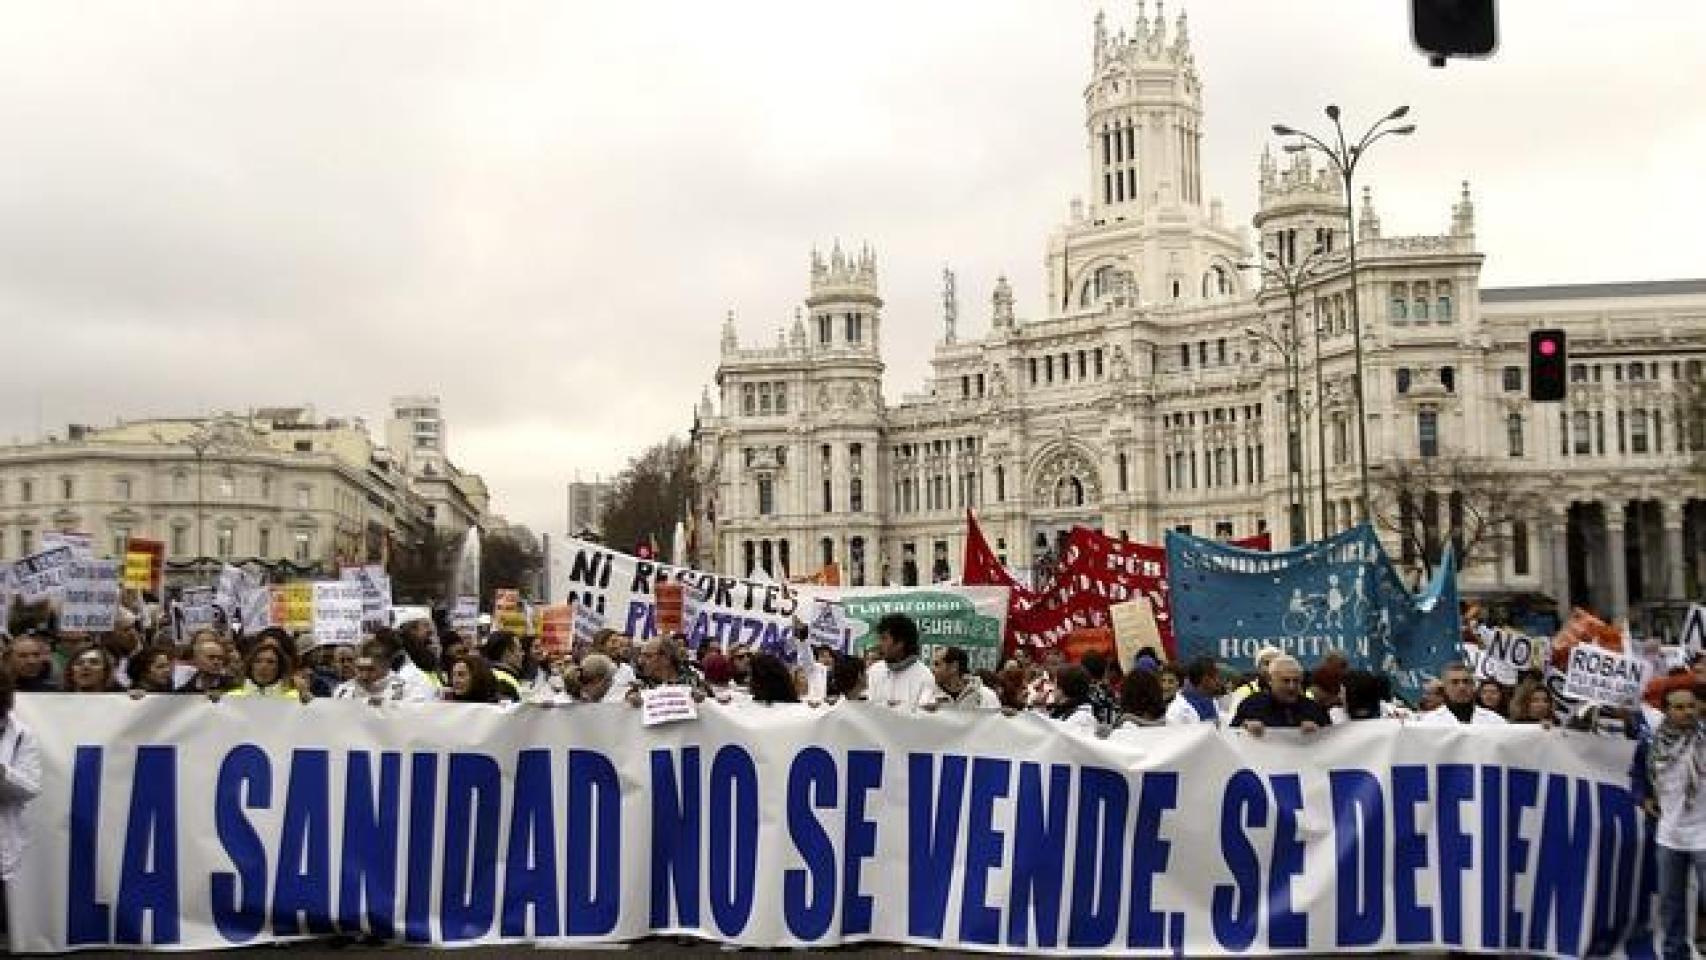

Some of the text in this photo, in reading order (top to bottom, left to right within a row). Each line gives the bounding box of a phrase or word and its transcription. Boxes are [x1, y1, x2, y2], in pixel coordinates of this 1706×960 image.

[569, 549, 614, 589] NI
[1486, 630, 1532, 666] NO
[66, 743, 1659, 959] LA SANIDAD NO SE VENDE, SE DEFIEND
